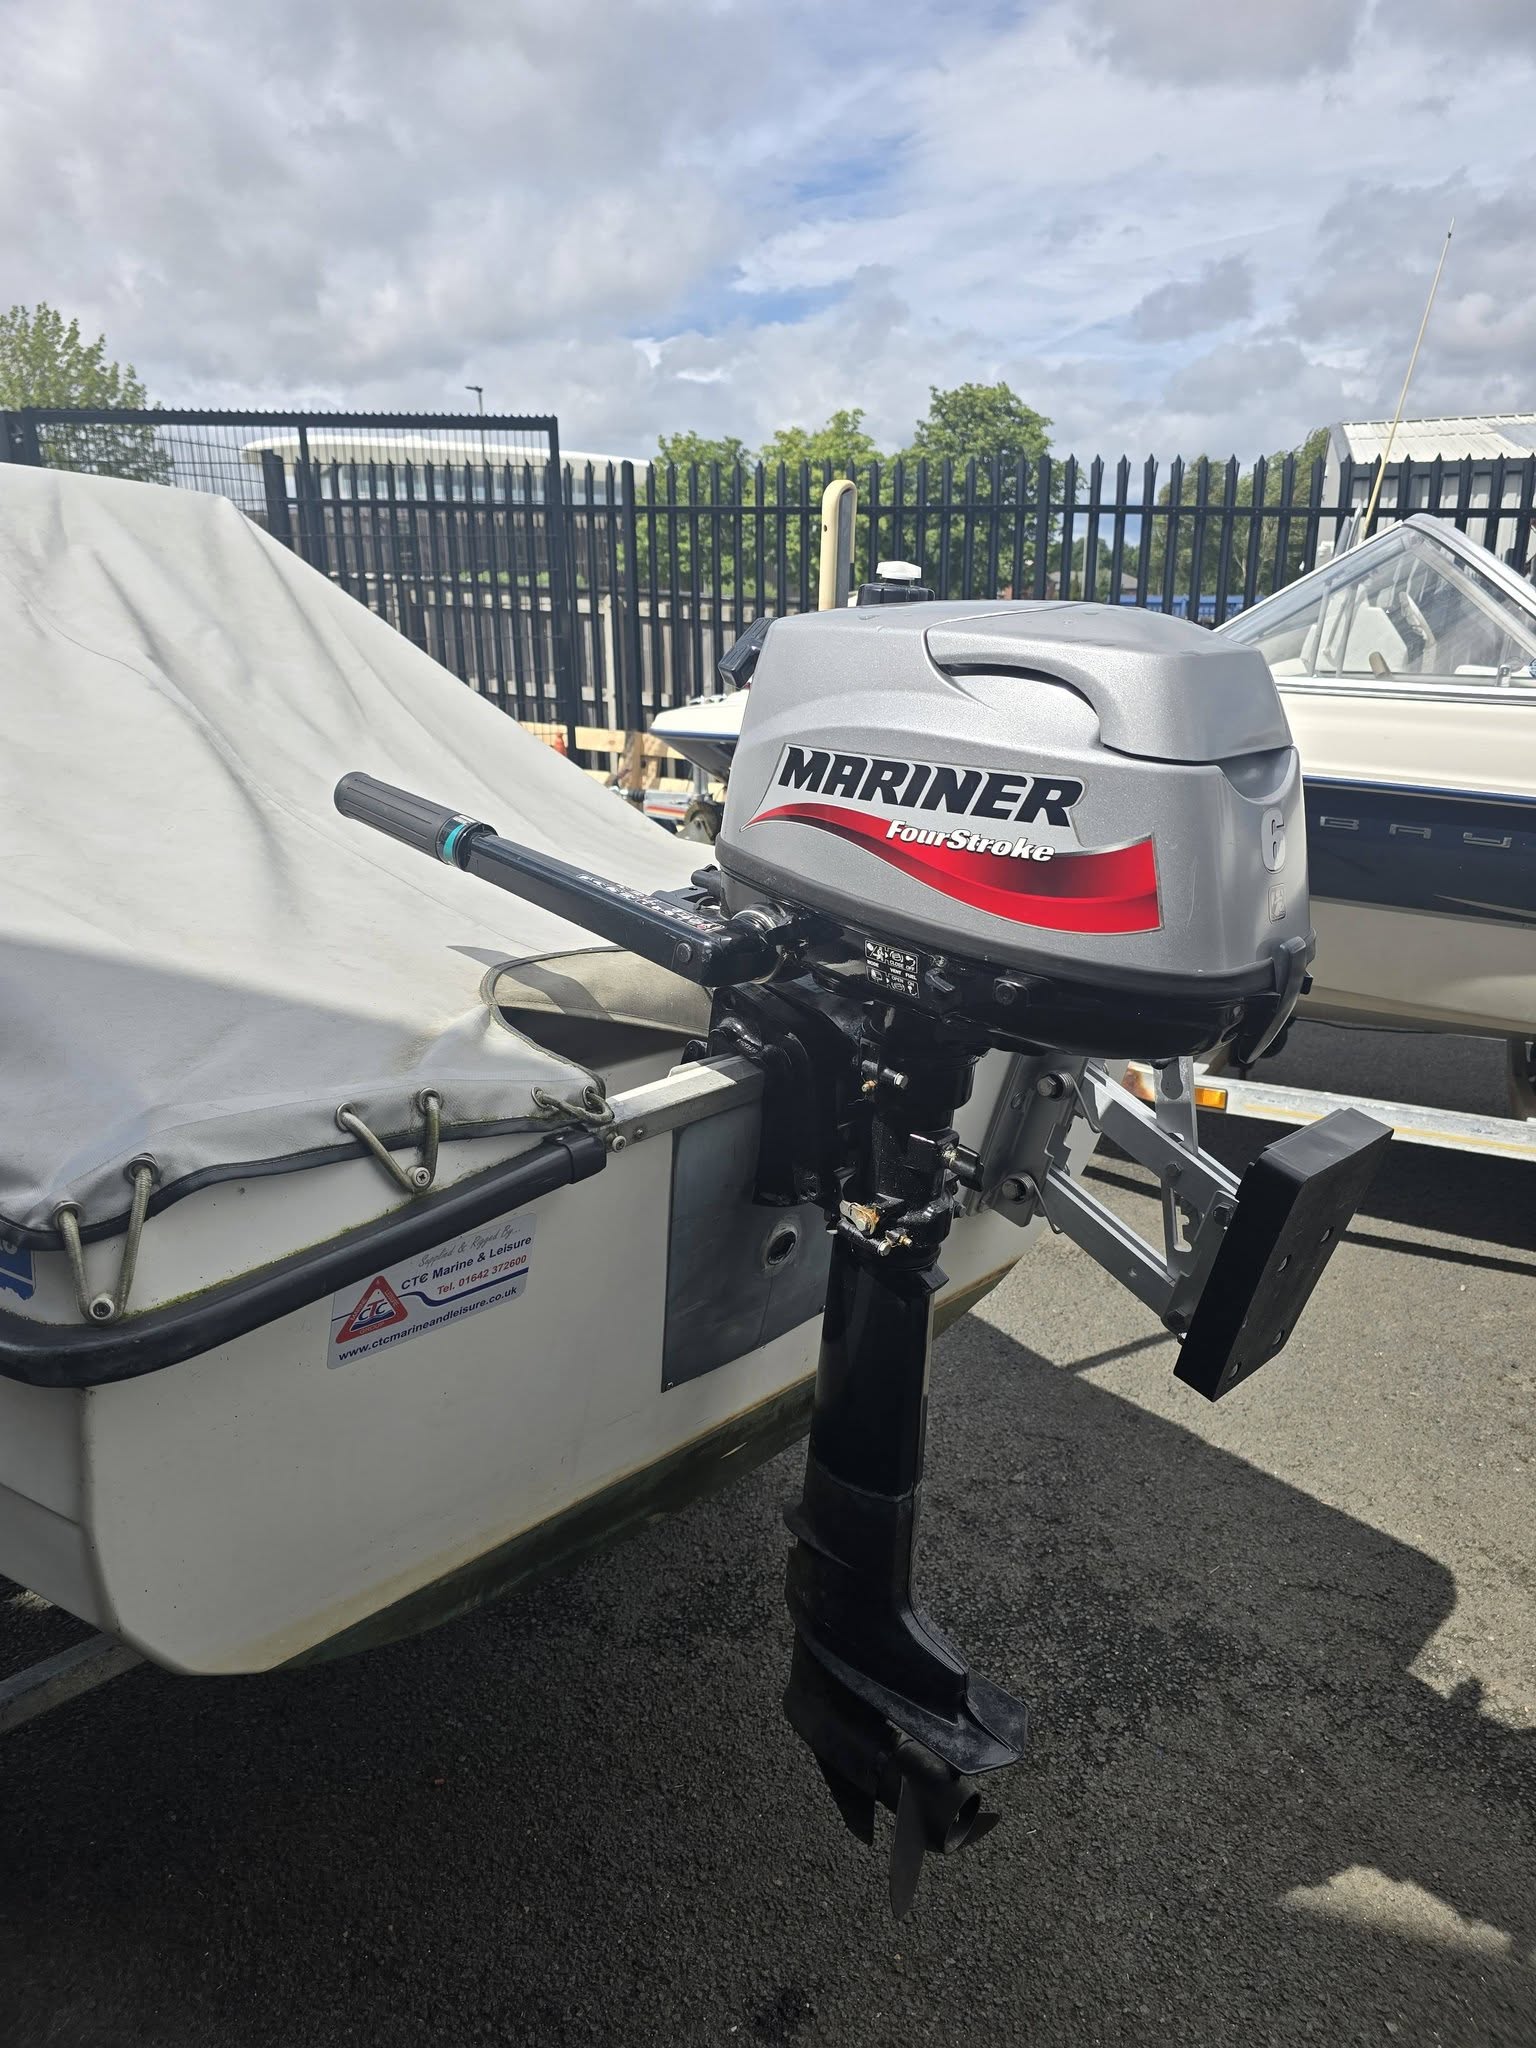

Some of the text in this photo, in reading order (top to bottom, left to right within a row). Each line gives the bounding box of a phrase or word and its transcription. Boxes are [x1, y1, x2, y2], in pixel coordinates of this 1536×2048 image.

[778, 746, 1087, 828] MARINER
[885, 819, 1057, 863] FourStroke
[1261, 806, 1286, 874] 6
[432, 1258, 474, 1280] Marine
[477, 1252, 486, 1262] &
[489, 1237, 532, 1259] Leisure
[437, 1254, 527, 1295] Tel. 01642 372600
[338, 1286, 518, 1361] www.ctcmarineandleisure.co.uk
[358, 1298, 389, 1321] CTC
